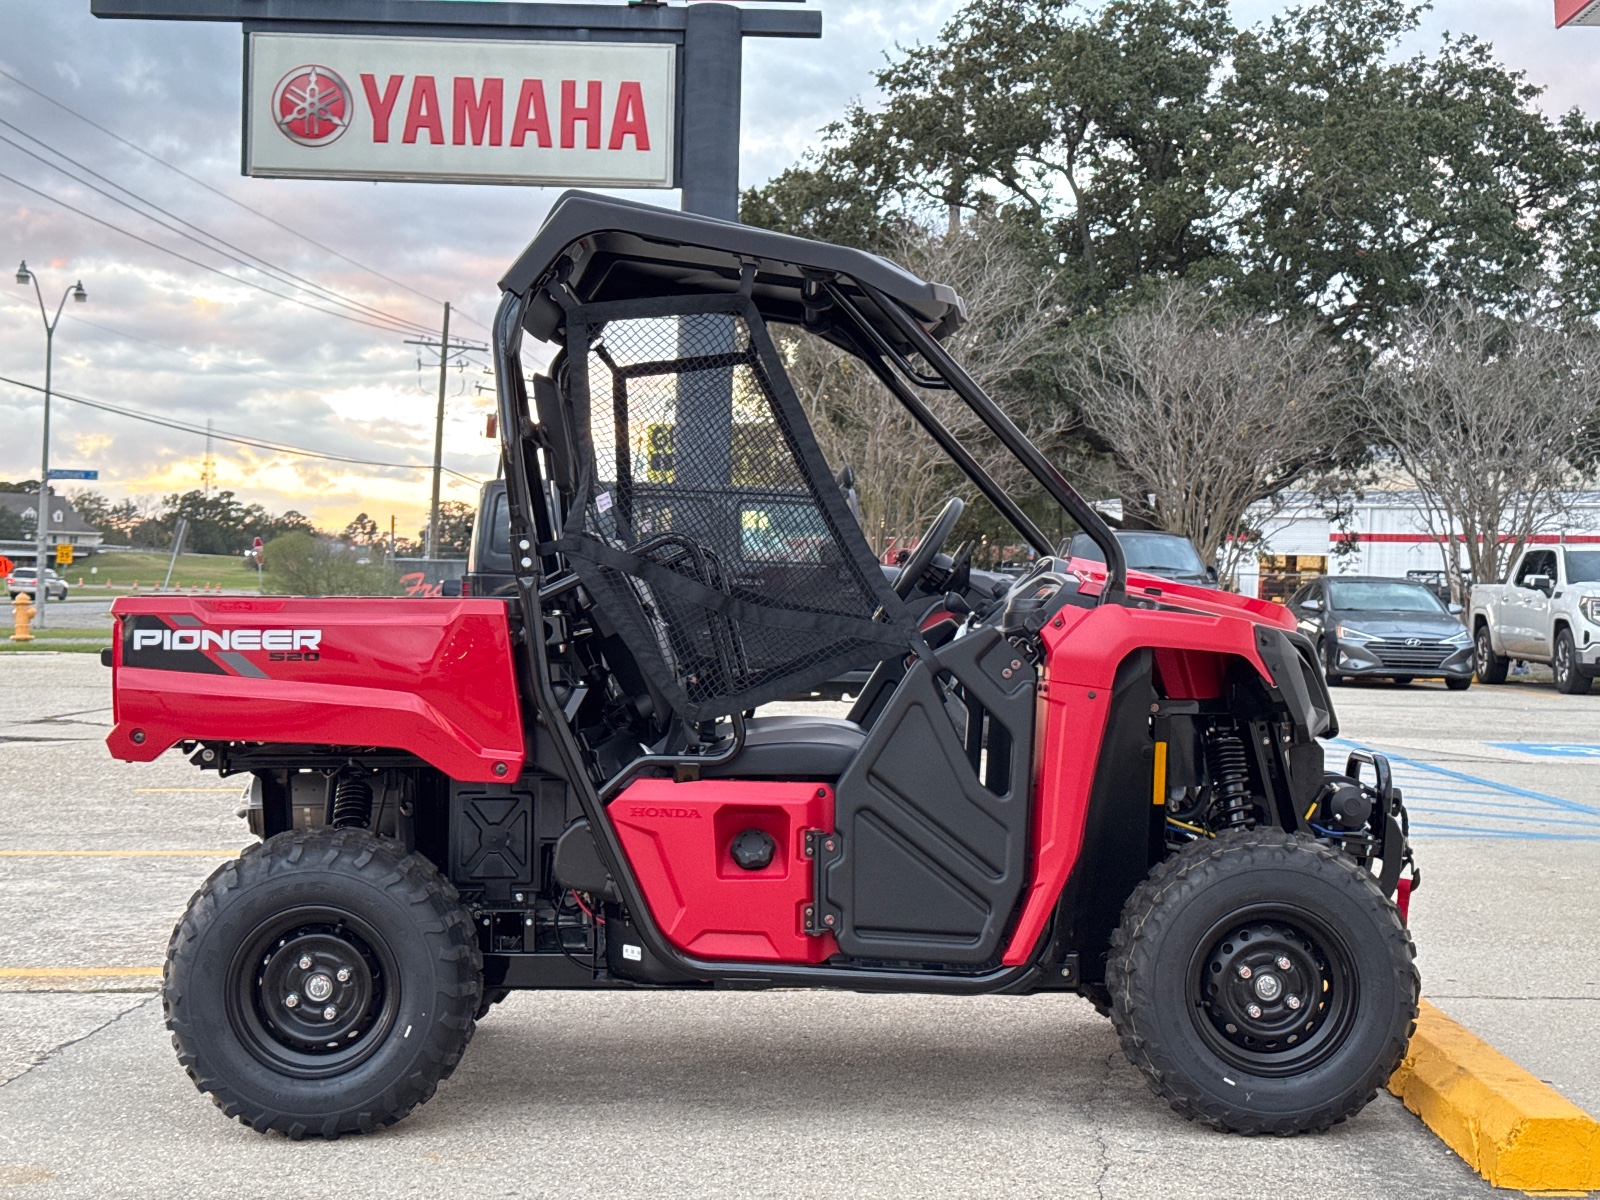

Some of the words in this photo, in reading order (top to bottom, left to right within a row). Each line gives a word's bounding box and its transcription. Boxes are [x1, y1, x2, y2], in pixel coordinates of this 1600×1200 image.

[361, 73, 650, 151] YAMAHA
[133, 629, 322, 651] PIONEER
[268, 653, 320, 662] 520
[630, 807, 702, 819] HONDA
